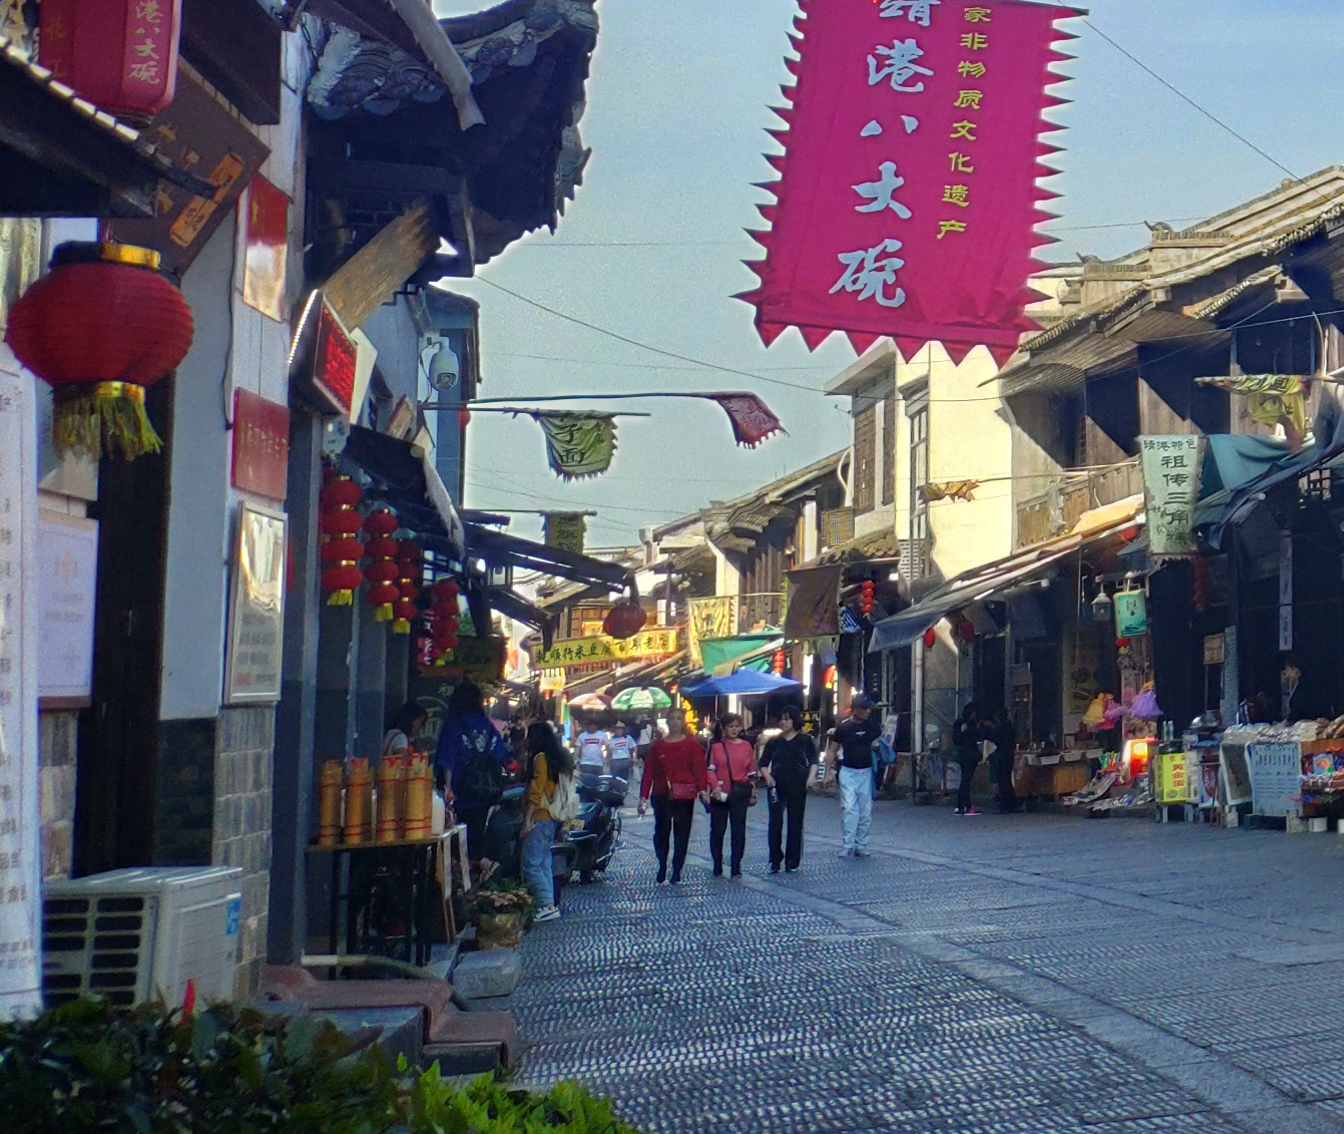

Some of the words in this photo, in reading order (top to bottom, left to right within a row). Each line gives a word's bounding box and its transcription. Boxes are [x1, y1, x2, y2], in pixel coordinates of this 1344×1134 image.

[936, 5, 992, 240] 家非物质文化遗产
